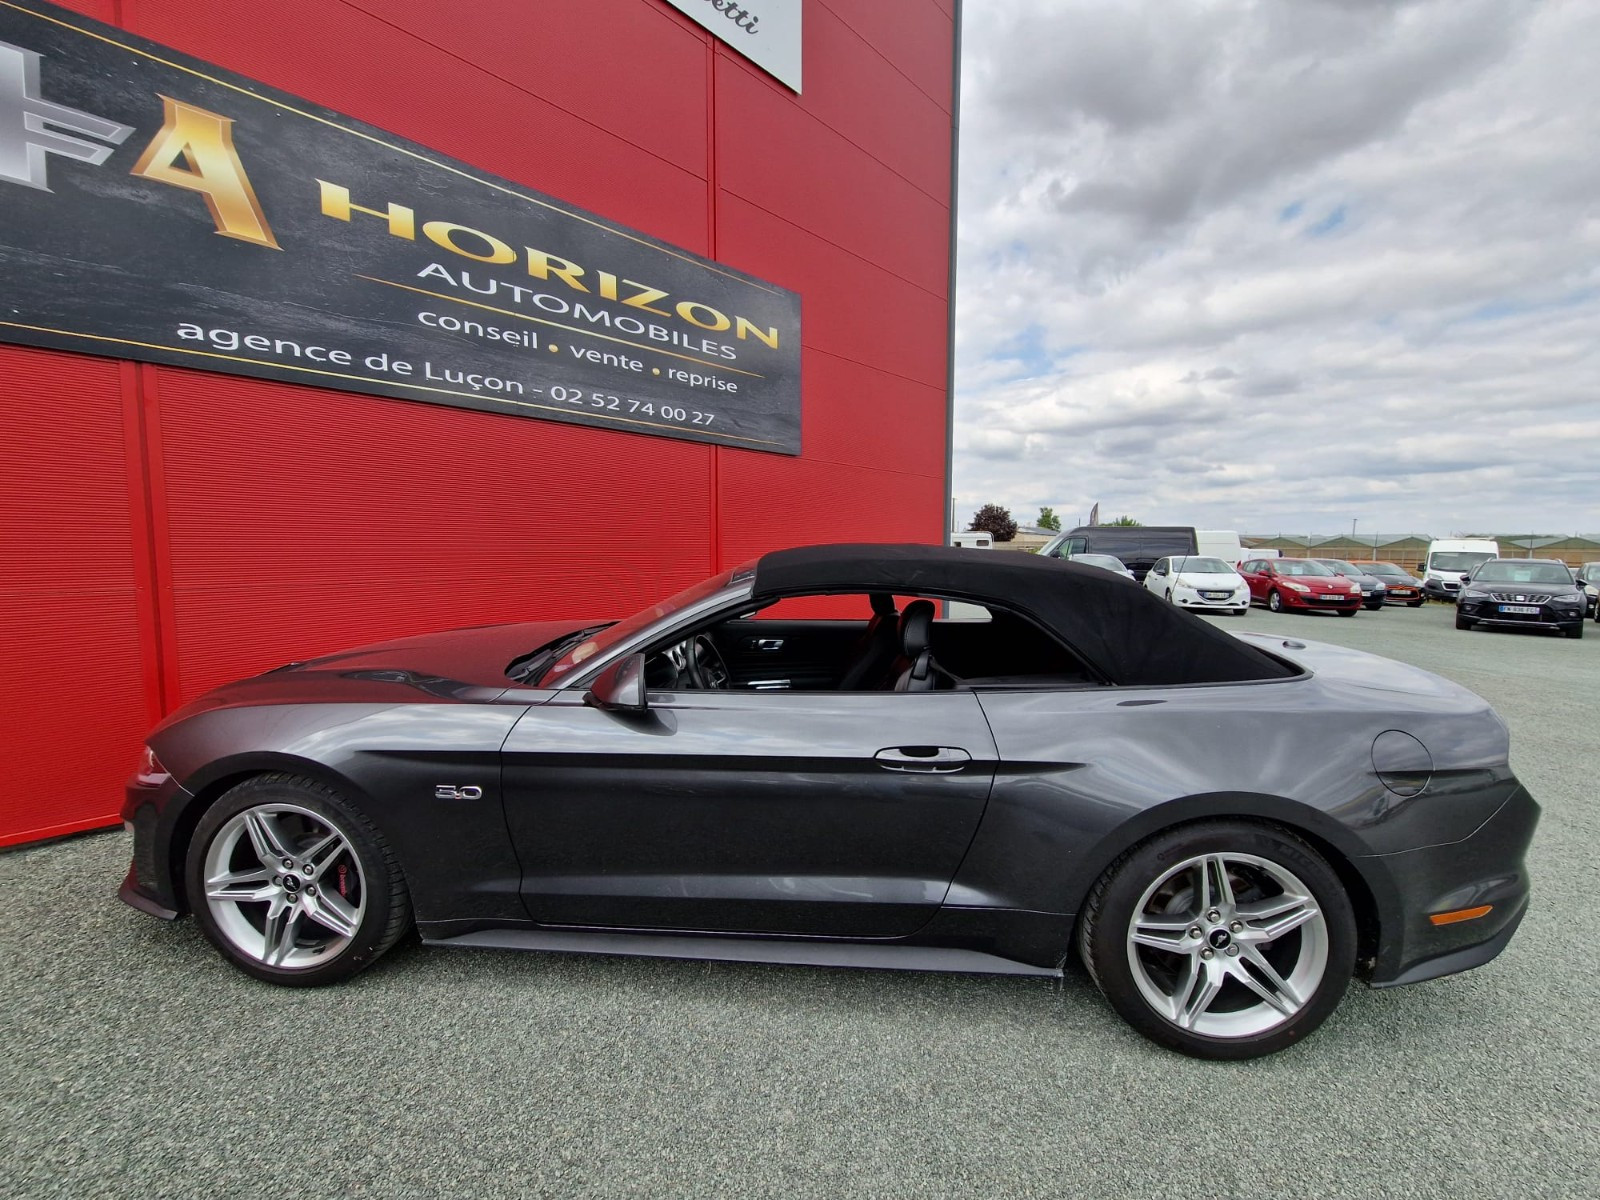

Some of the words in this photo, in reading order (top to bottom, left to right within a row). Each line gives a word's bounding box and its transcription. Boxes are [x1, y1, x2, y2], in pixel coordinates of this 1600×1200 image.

[704, 0, 759, 34] etti
[315, 178, 779, 349] HORIZON
[417, 263, 737, 360] AUTOMOBILES
[176, 322, 352, 366] agence
[364, 353, 413, 375] de
[425, 361, 523, 395] Luçon
[550, 385, 583, 404] 02
[591, 393, 620, 411] 52
[627, 400, 655, 416] 74
[660, 405, 687, 421] 00
[691, 411, 715, 426] 27
[417, 311, 538, 349] conseil
[569, 345, 644, 372] vente
[668, 366, 738, 393] reprise
